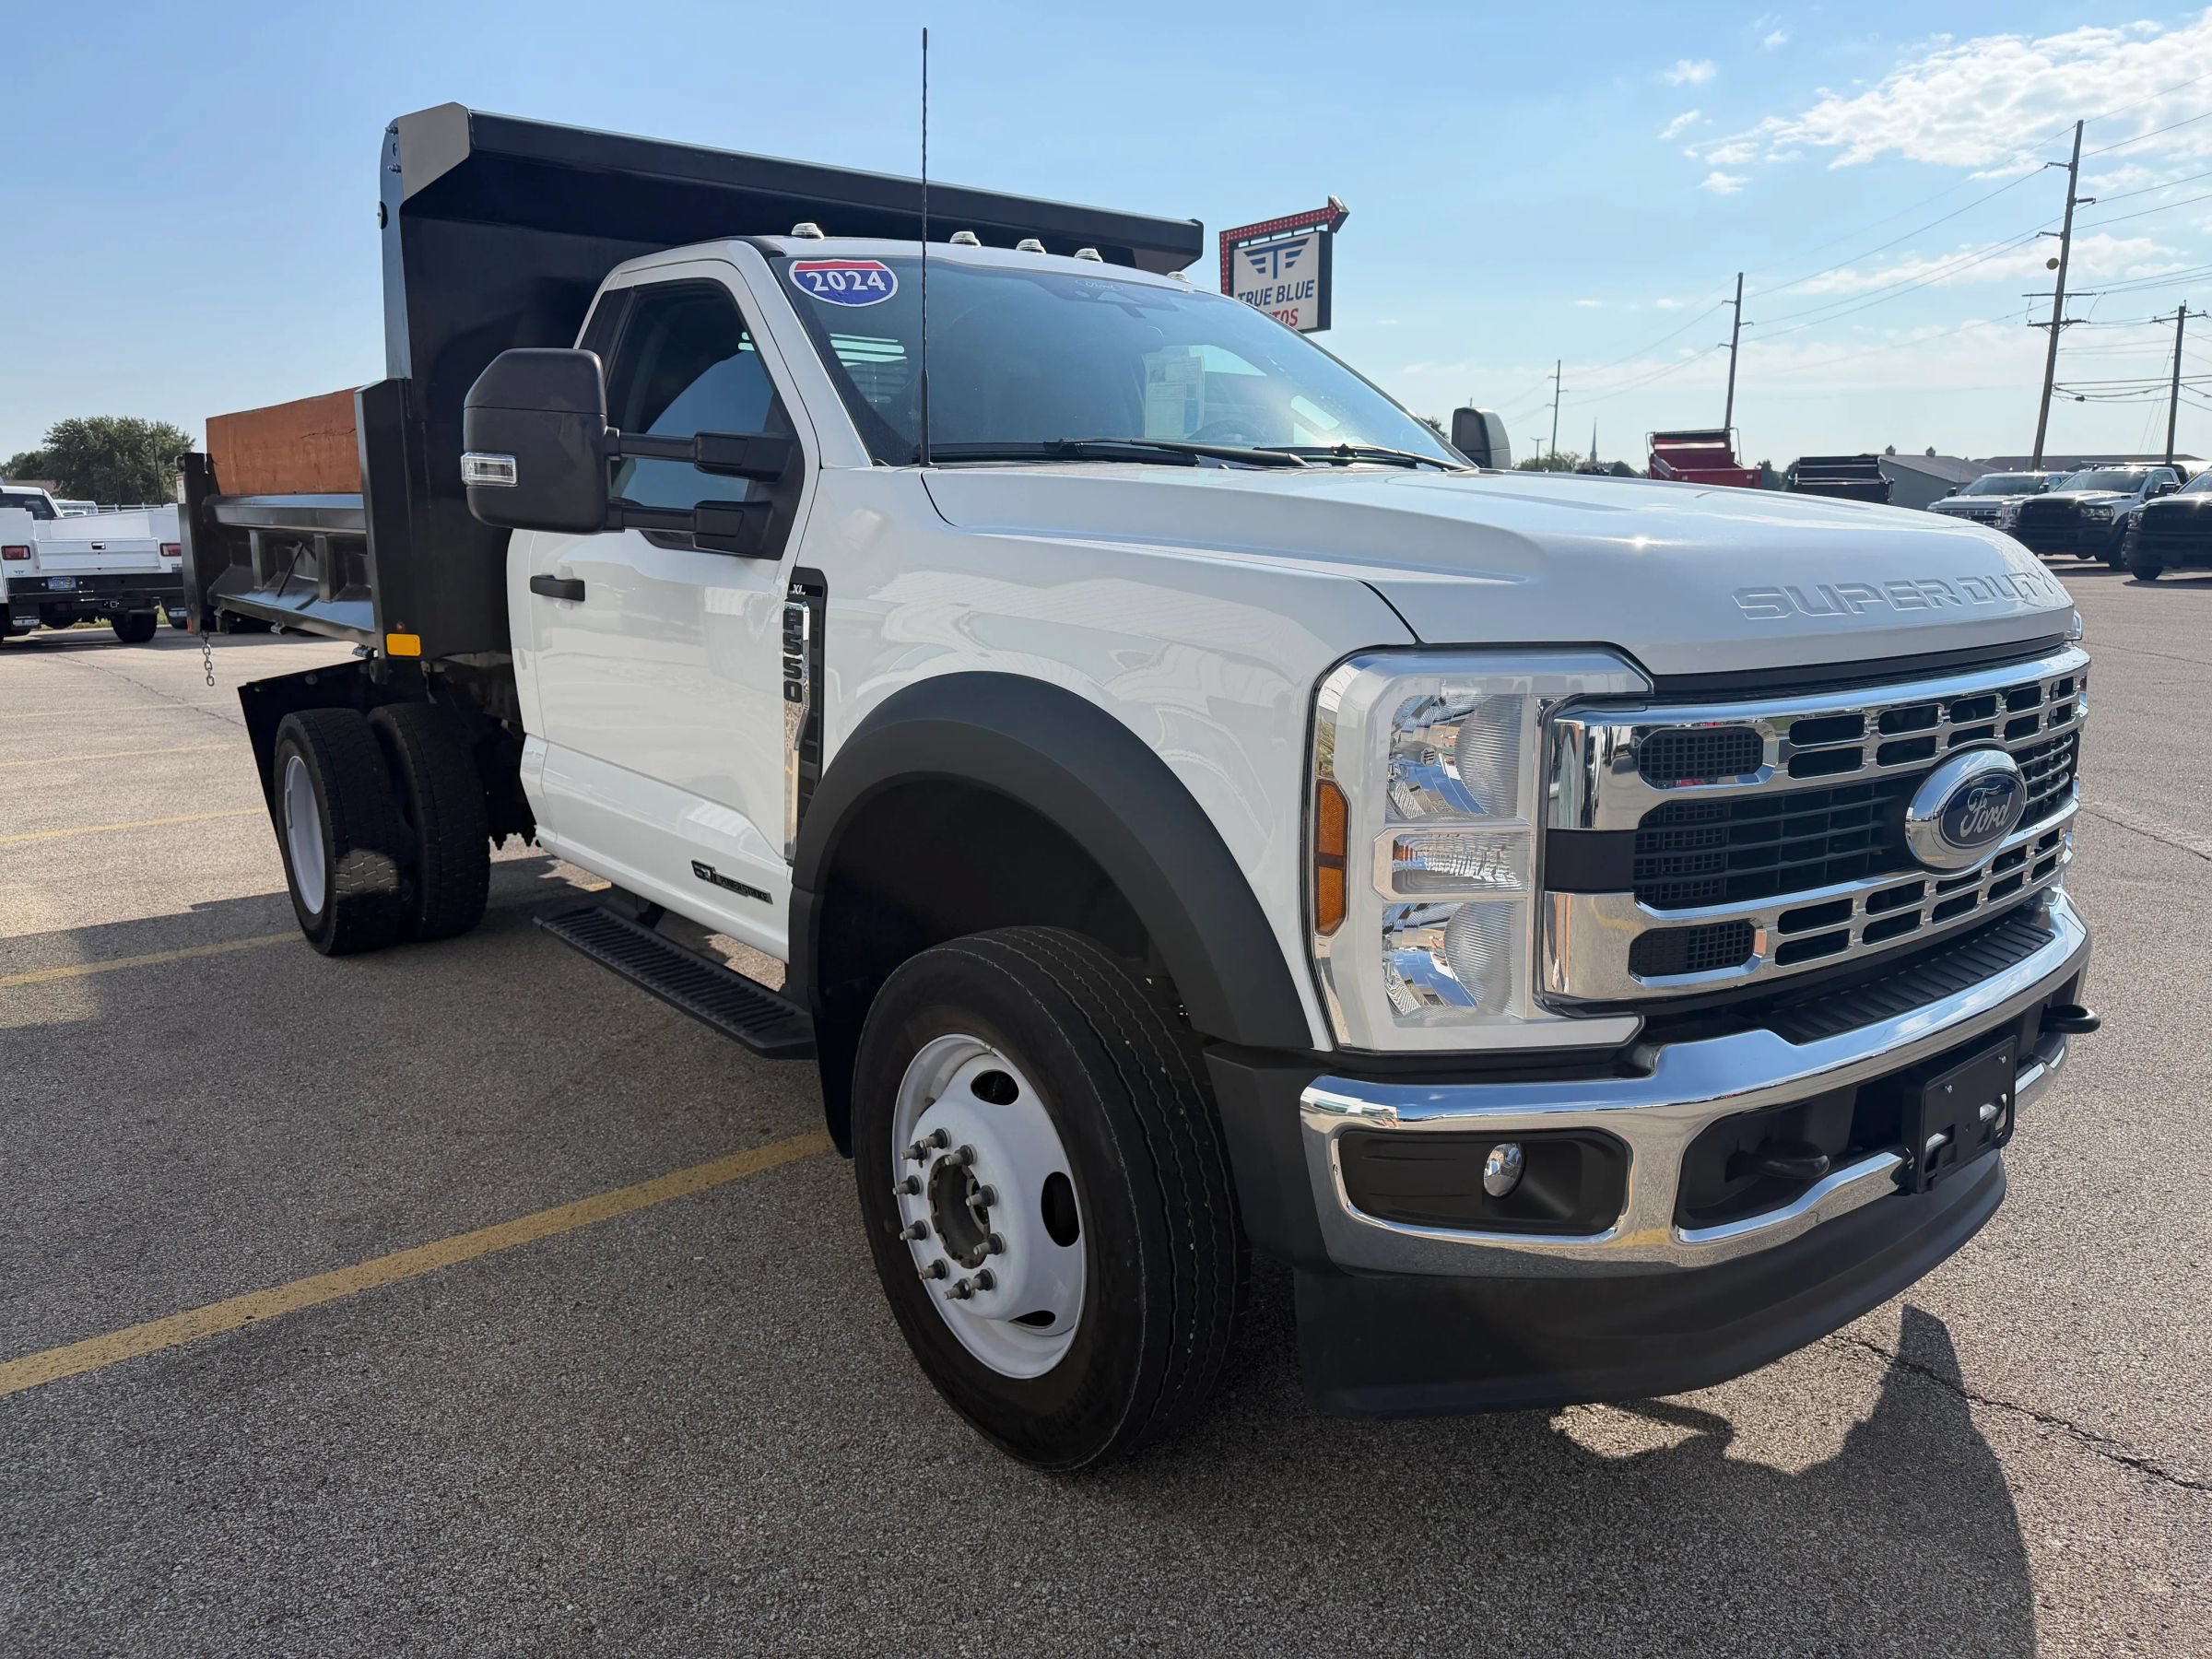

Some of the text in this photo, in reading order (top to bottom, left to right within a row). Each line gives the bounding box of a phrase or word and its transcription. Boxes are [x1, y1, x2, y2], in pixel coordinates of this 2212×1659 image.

[806, 270, 887, 292] 2024
[1238, 280, 1315, 307] TRUE BLUE
[1732, 561, 2065, 620] SUPER DUTY
[1960, 784, 2013, 838] Ford
